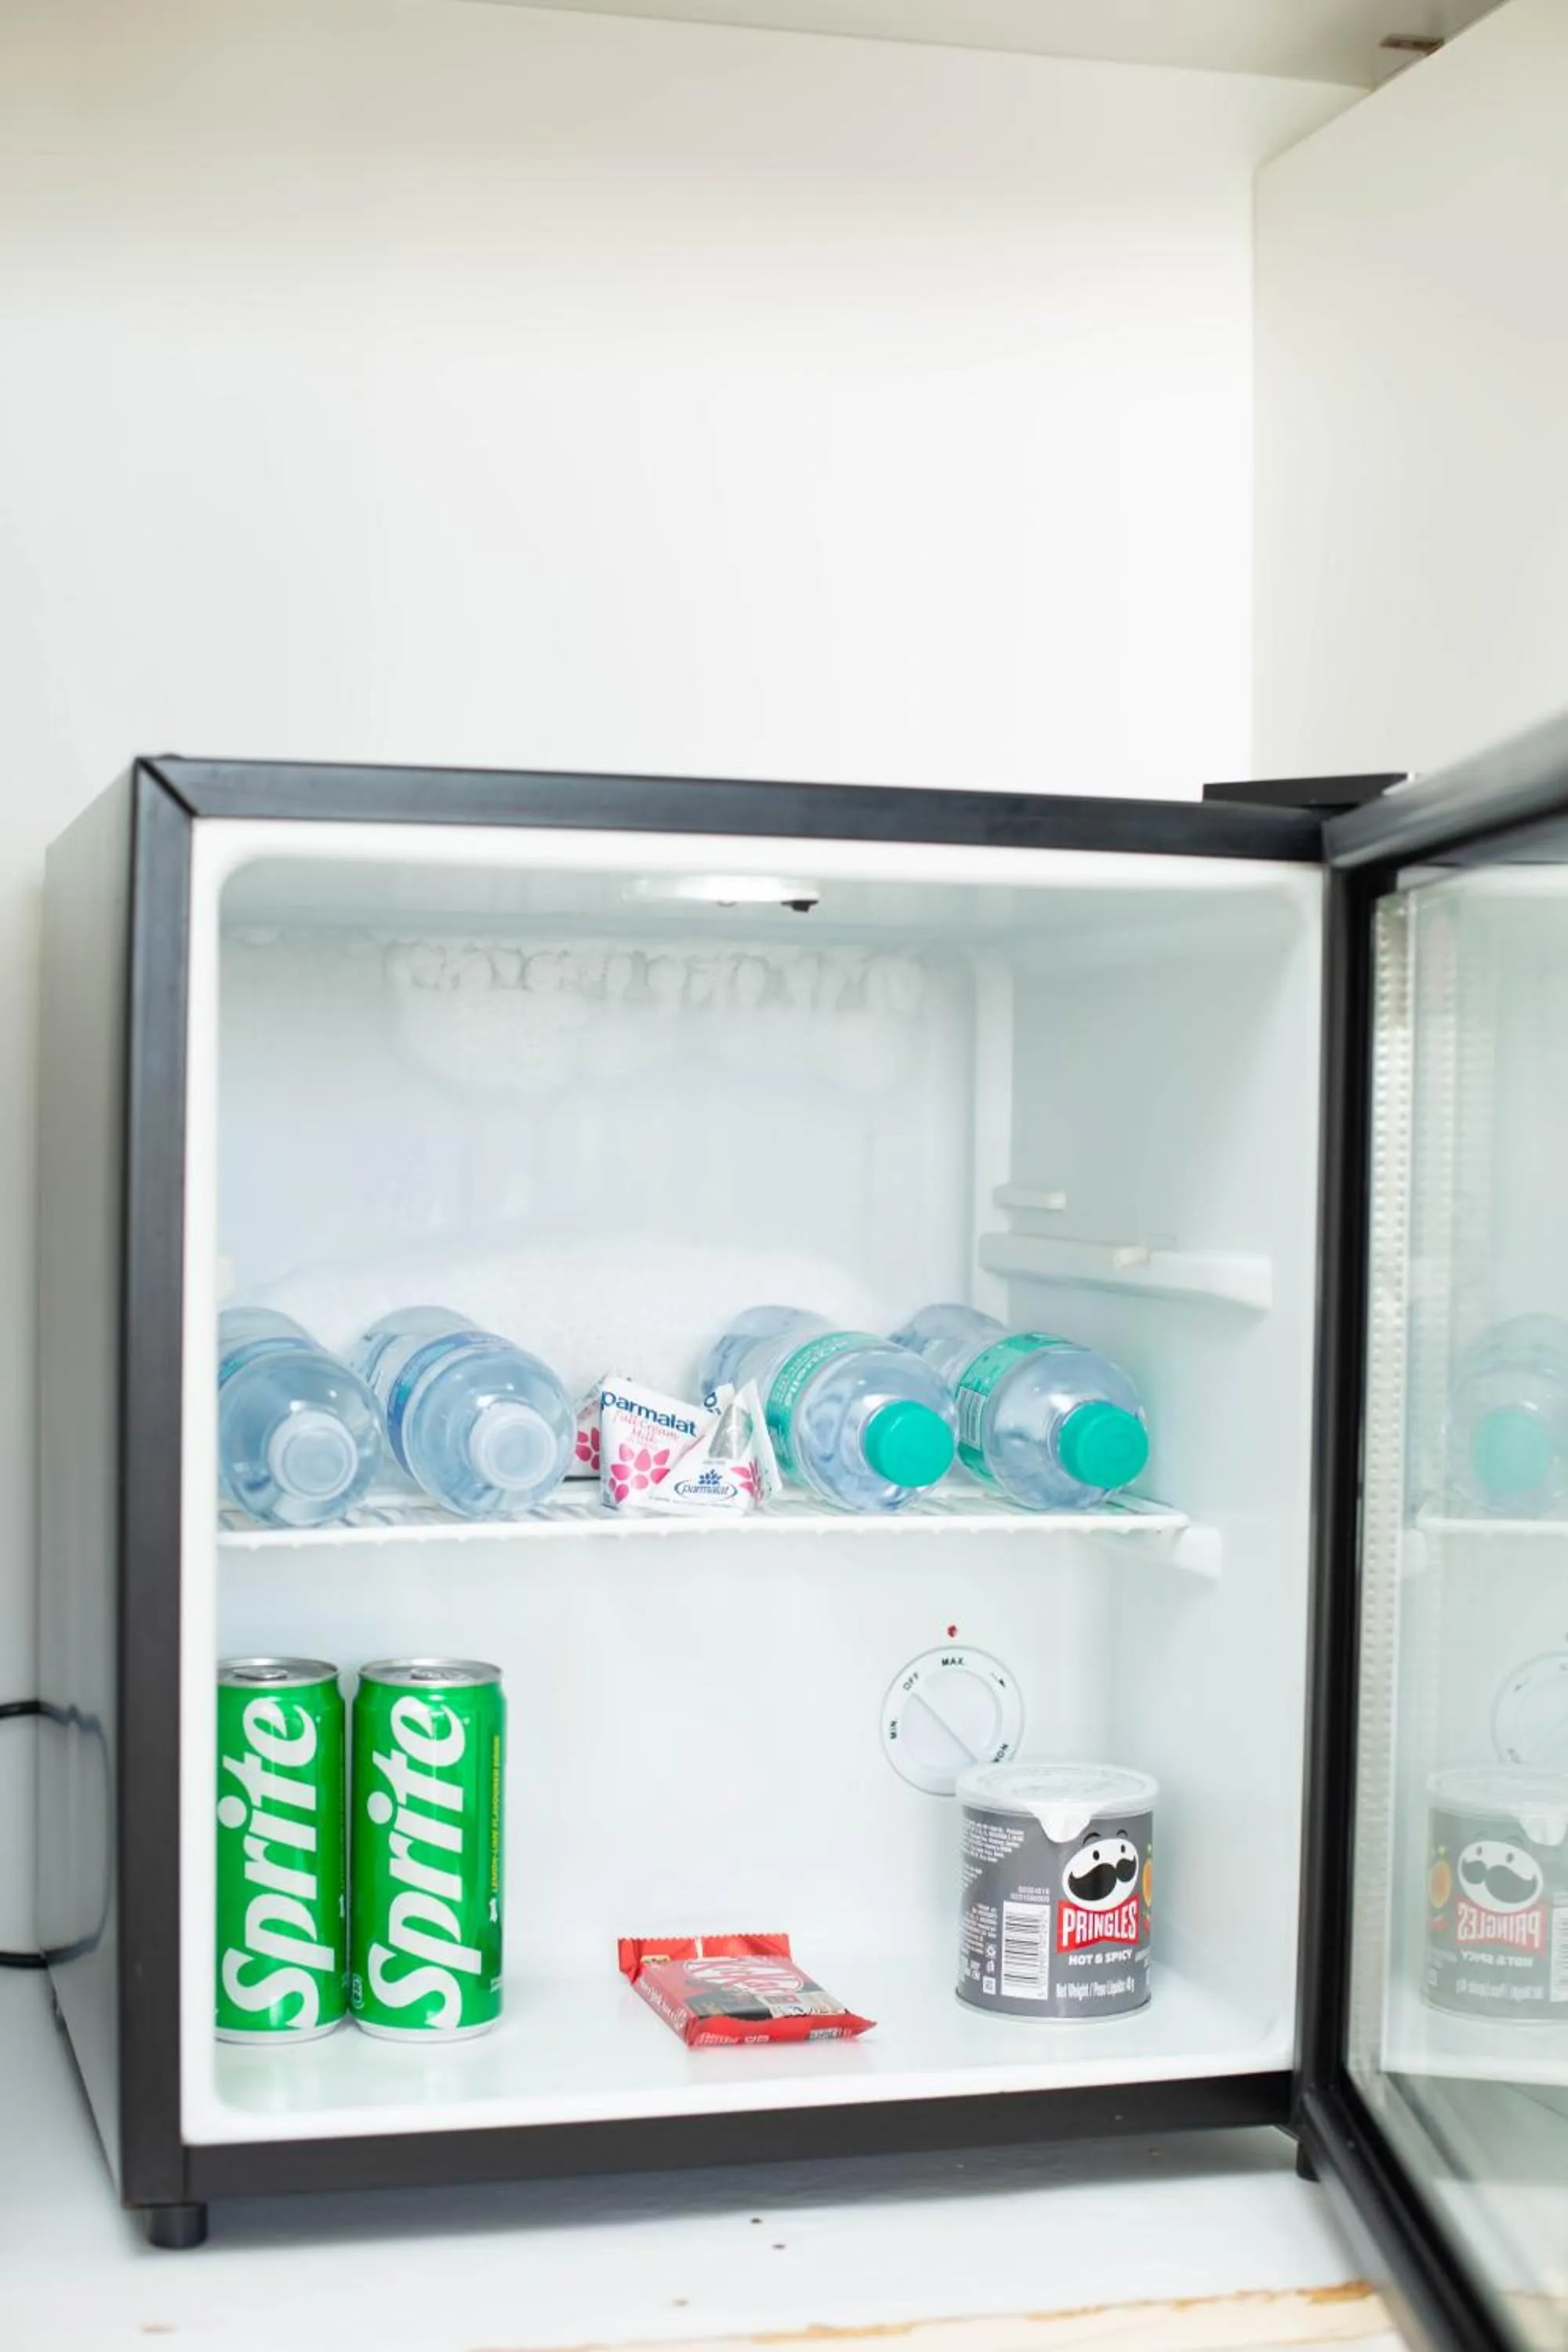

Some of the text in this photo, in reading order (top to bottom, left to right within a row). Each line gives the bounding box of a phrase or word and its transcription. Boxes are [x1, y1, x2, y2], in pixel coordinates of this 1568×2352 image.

[601, 1391, 697, 1437] parmalat
[682, 1483, 730, 1495] parmalat
[903, 1672, 919, 1691] OFF
[218, 1697, 335, 2028] Sprite
[367, 1696, 482, 2030] Sprite
[1062, 1900, 1137, 1947] PRINGLES
[1068, 1954, 1094, 1966] HOT
[1105, 1947, 1134, 1964] SPICY
